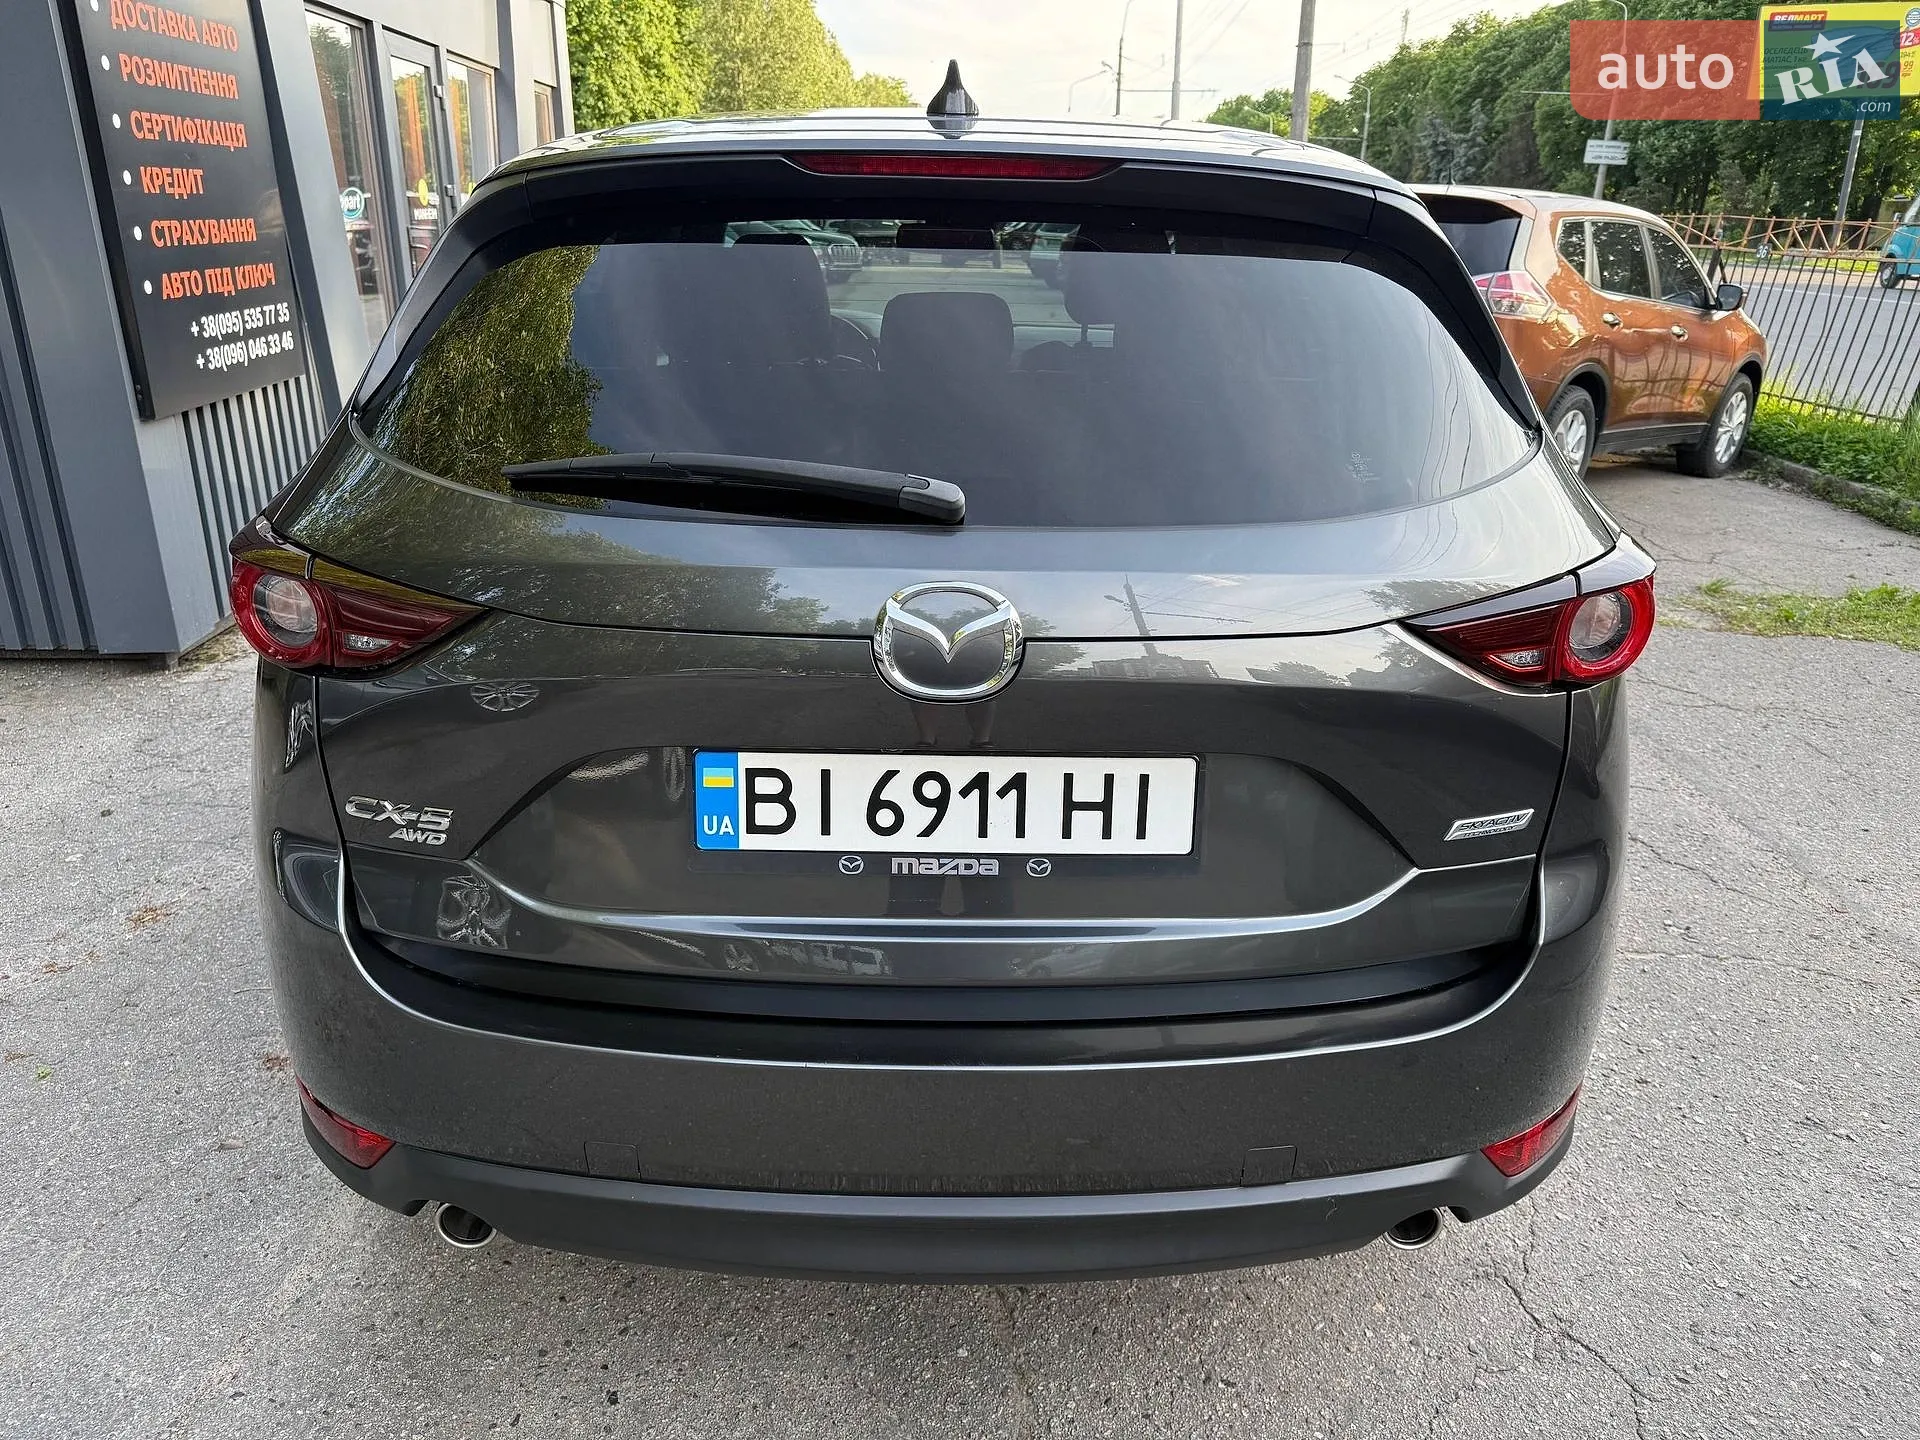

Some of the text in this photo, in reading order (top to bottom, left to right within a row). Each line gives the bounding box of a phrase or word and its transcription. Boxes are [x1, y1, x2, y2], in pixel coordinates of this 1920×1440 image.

[111, 0, 239, 52] ДОСТАВКА АВТО
[1774, 14, 1825, 25] ВЕЛМАРТ
[119, 53, 239, 100] РОЗМИТНЕННЯ
[130, 110, 248, 152] СЕРТИФІКАЦІЯ
[140, 166, 204, 200] КРЕДИТ
[151, 218, 257, 248] СТРАХУВАННЯ
[162, 262, 276, 300] АВТО ПІД КЛЮЧ
[201, 310, 243, 340] 38(095)
[244, 306, 263, 330] 535
[263, 304, 276, 325] 77
[277, 302, 290, 323] 35
[206, 341, 248, 372] 38(096)
[248, 336, 268, 360] 046
[268, 333, 281, 355] 33
[281, 331, 294, 351] 46
[345, 795, 454, 831] CX-5
[745, 767, 1150, 840] BI 6911 HI
[388, 827, 448, 846] AWD
[703, 816, 734, 836] UA
[1460, 814, 1528, 831] SKYACTIV
